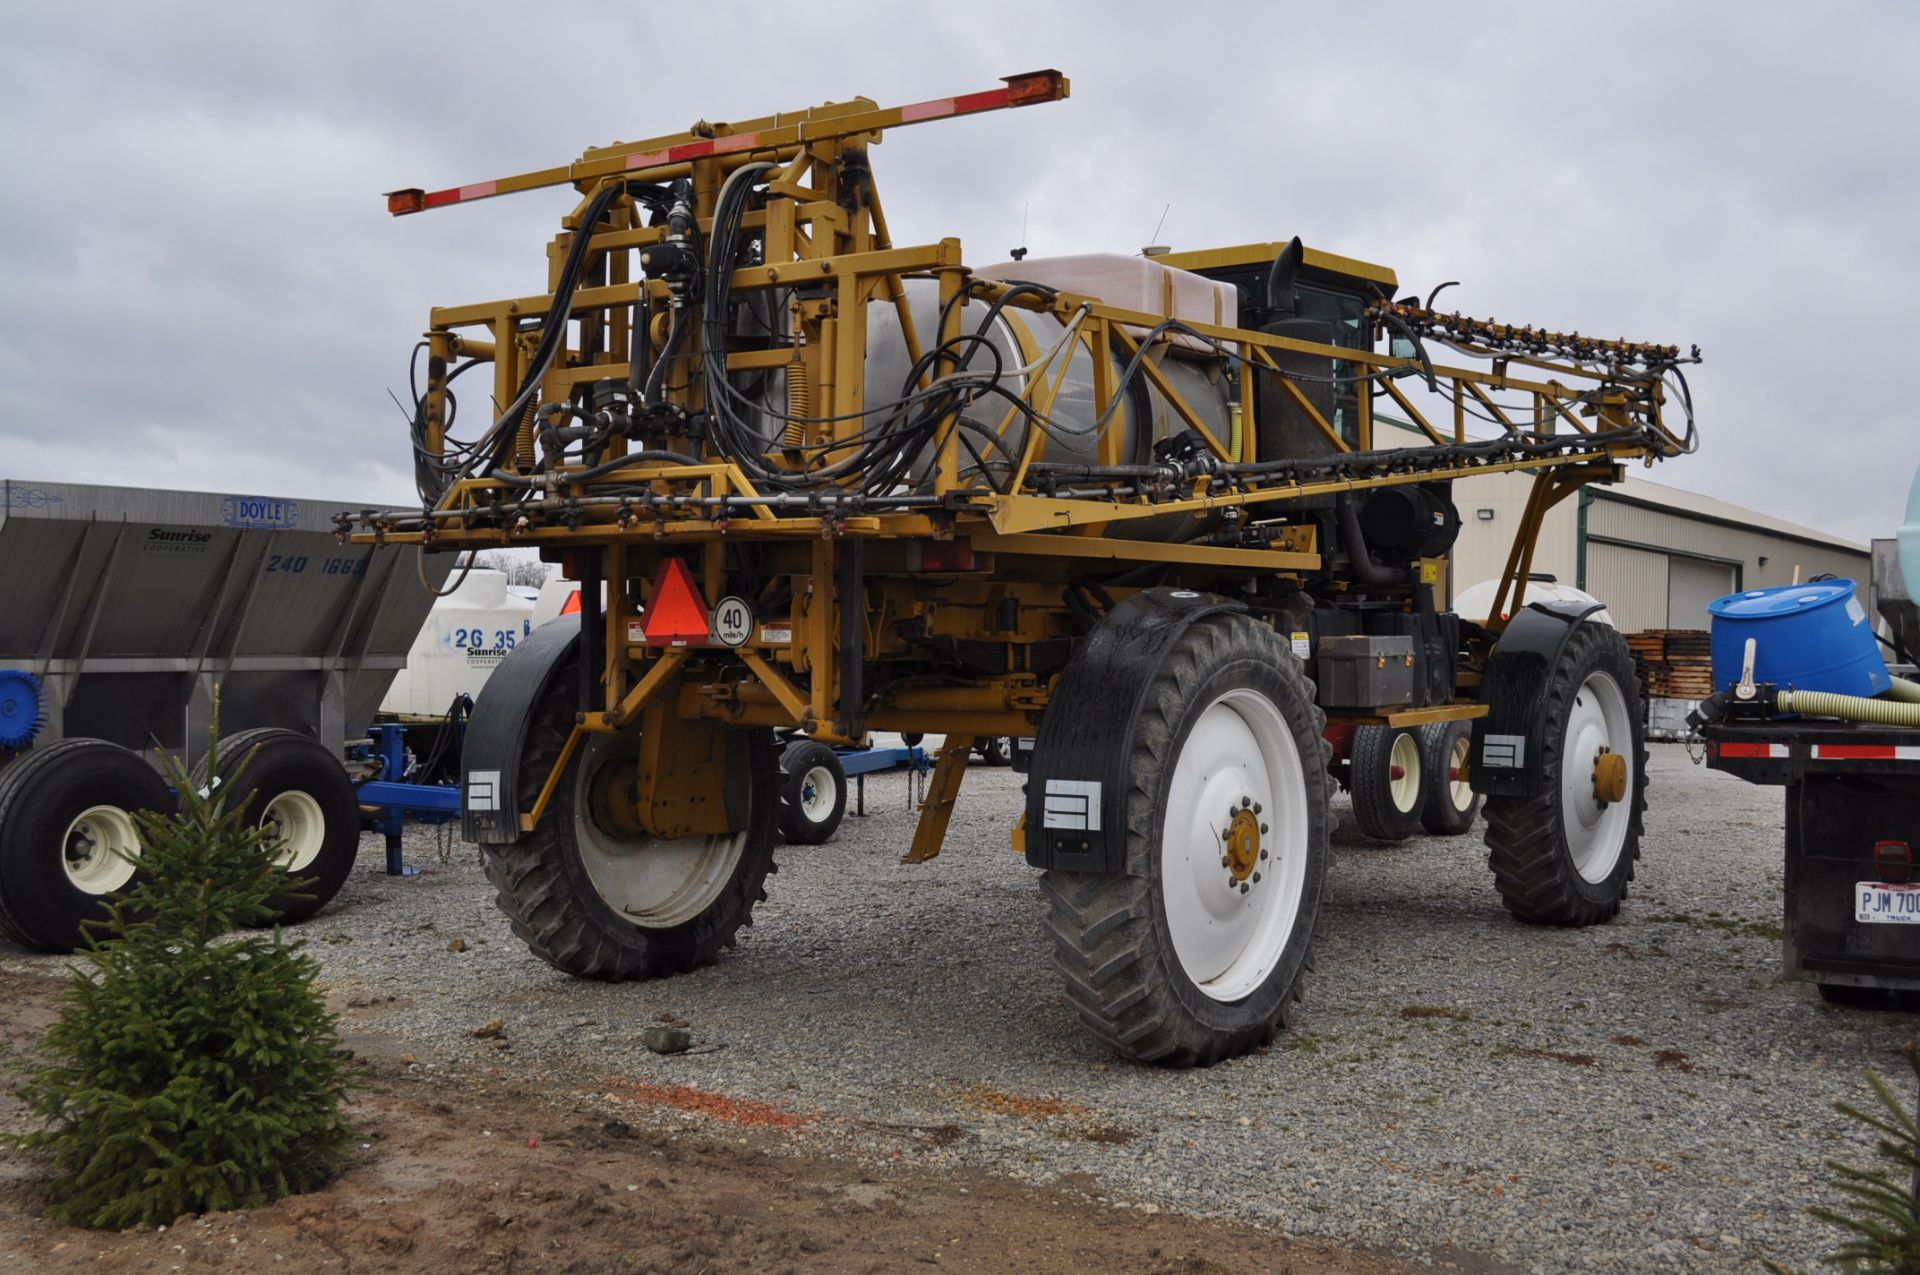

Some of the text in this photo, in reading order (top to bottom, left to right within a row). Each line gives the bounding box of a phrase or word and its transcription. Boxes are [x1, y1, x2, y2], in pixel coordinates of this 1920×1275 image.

[239, 501, 282, 520] DOYLE
[148, 528, 212, 542] Sunrise
[266, 554, 309, 574] 240
[723, 609, 742, 630] 40
[495, 630, 516, 649] 35
[466, 646, 507, 656] Sunrise
[1862, 892, 1892, 913] PJM
